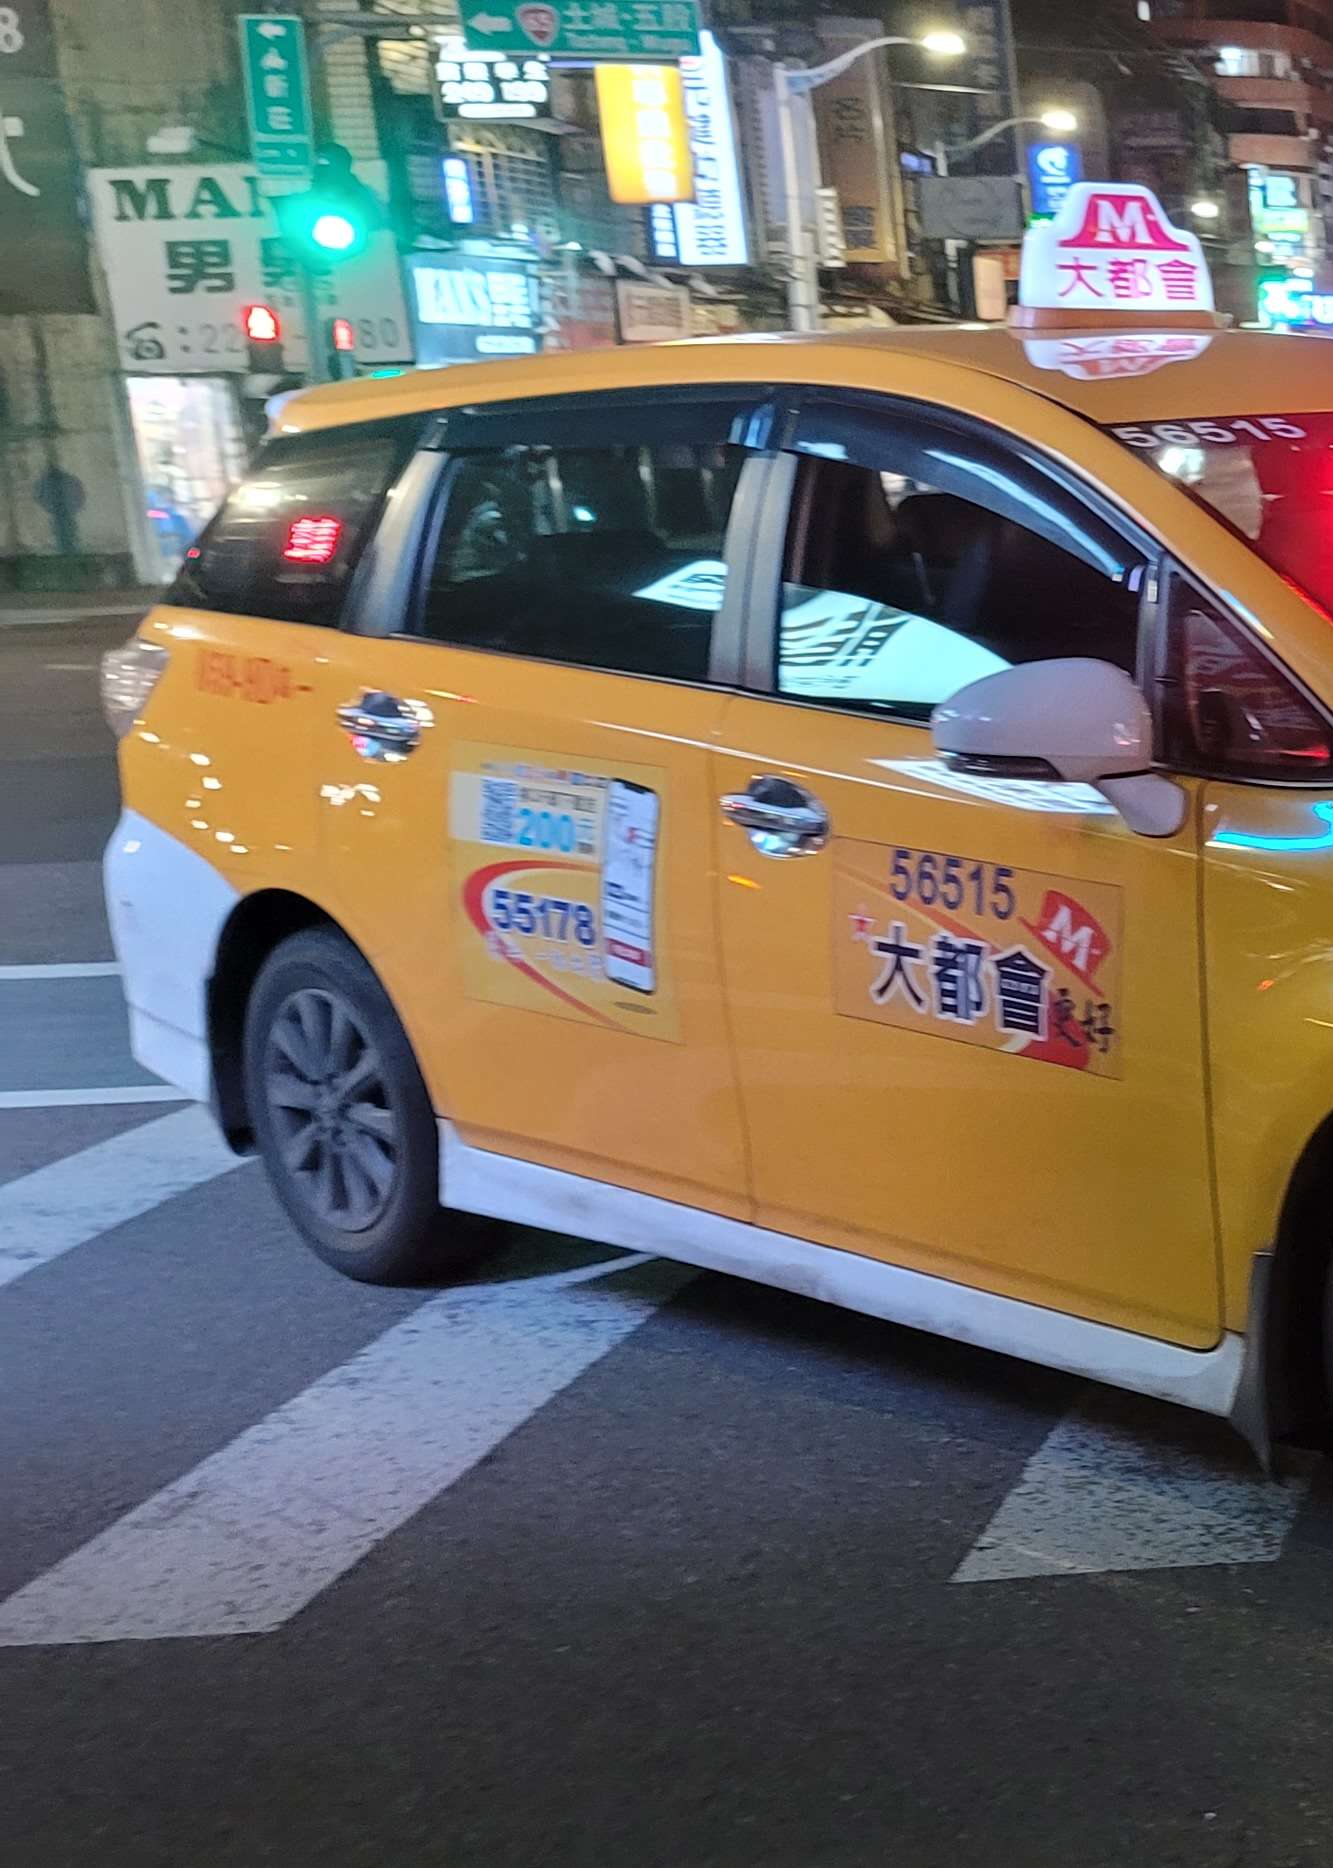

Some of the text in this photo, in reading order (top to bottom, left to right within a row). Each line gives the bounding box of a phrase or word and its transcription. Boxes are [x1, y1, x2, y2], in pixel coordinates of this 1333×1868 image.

[1095, 198, 1154, 243] M
[1056, 256, 1199, 300] 大都會
[1112, 418, 1306, 447] 56515
[889, 849, 1015, 920] 56515
[492, 888, 597, 946] 55178
[870, 921, 1051, 1041] 大都會
